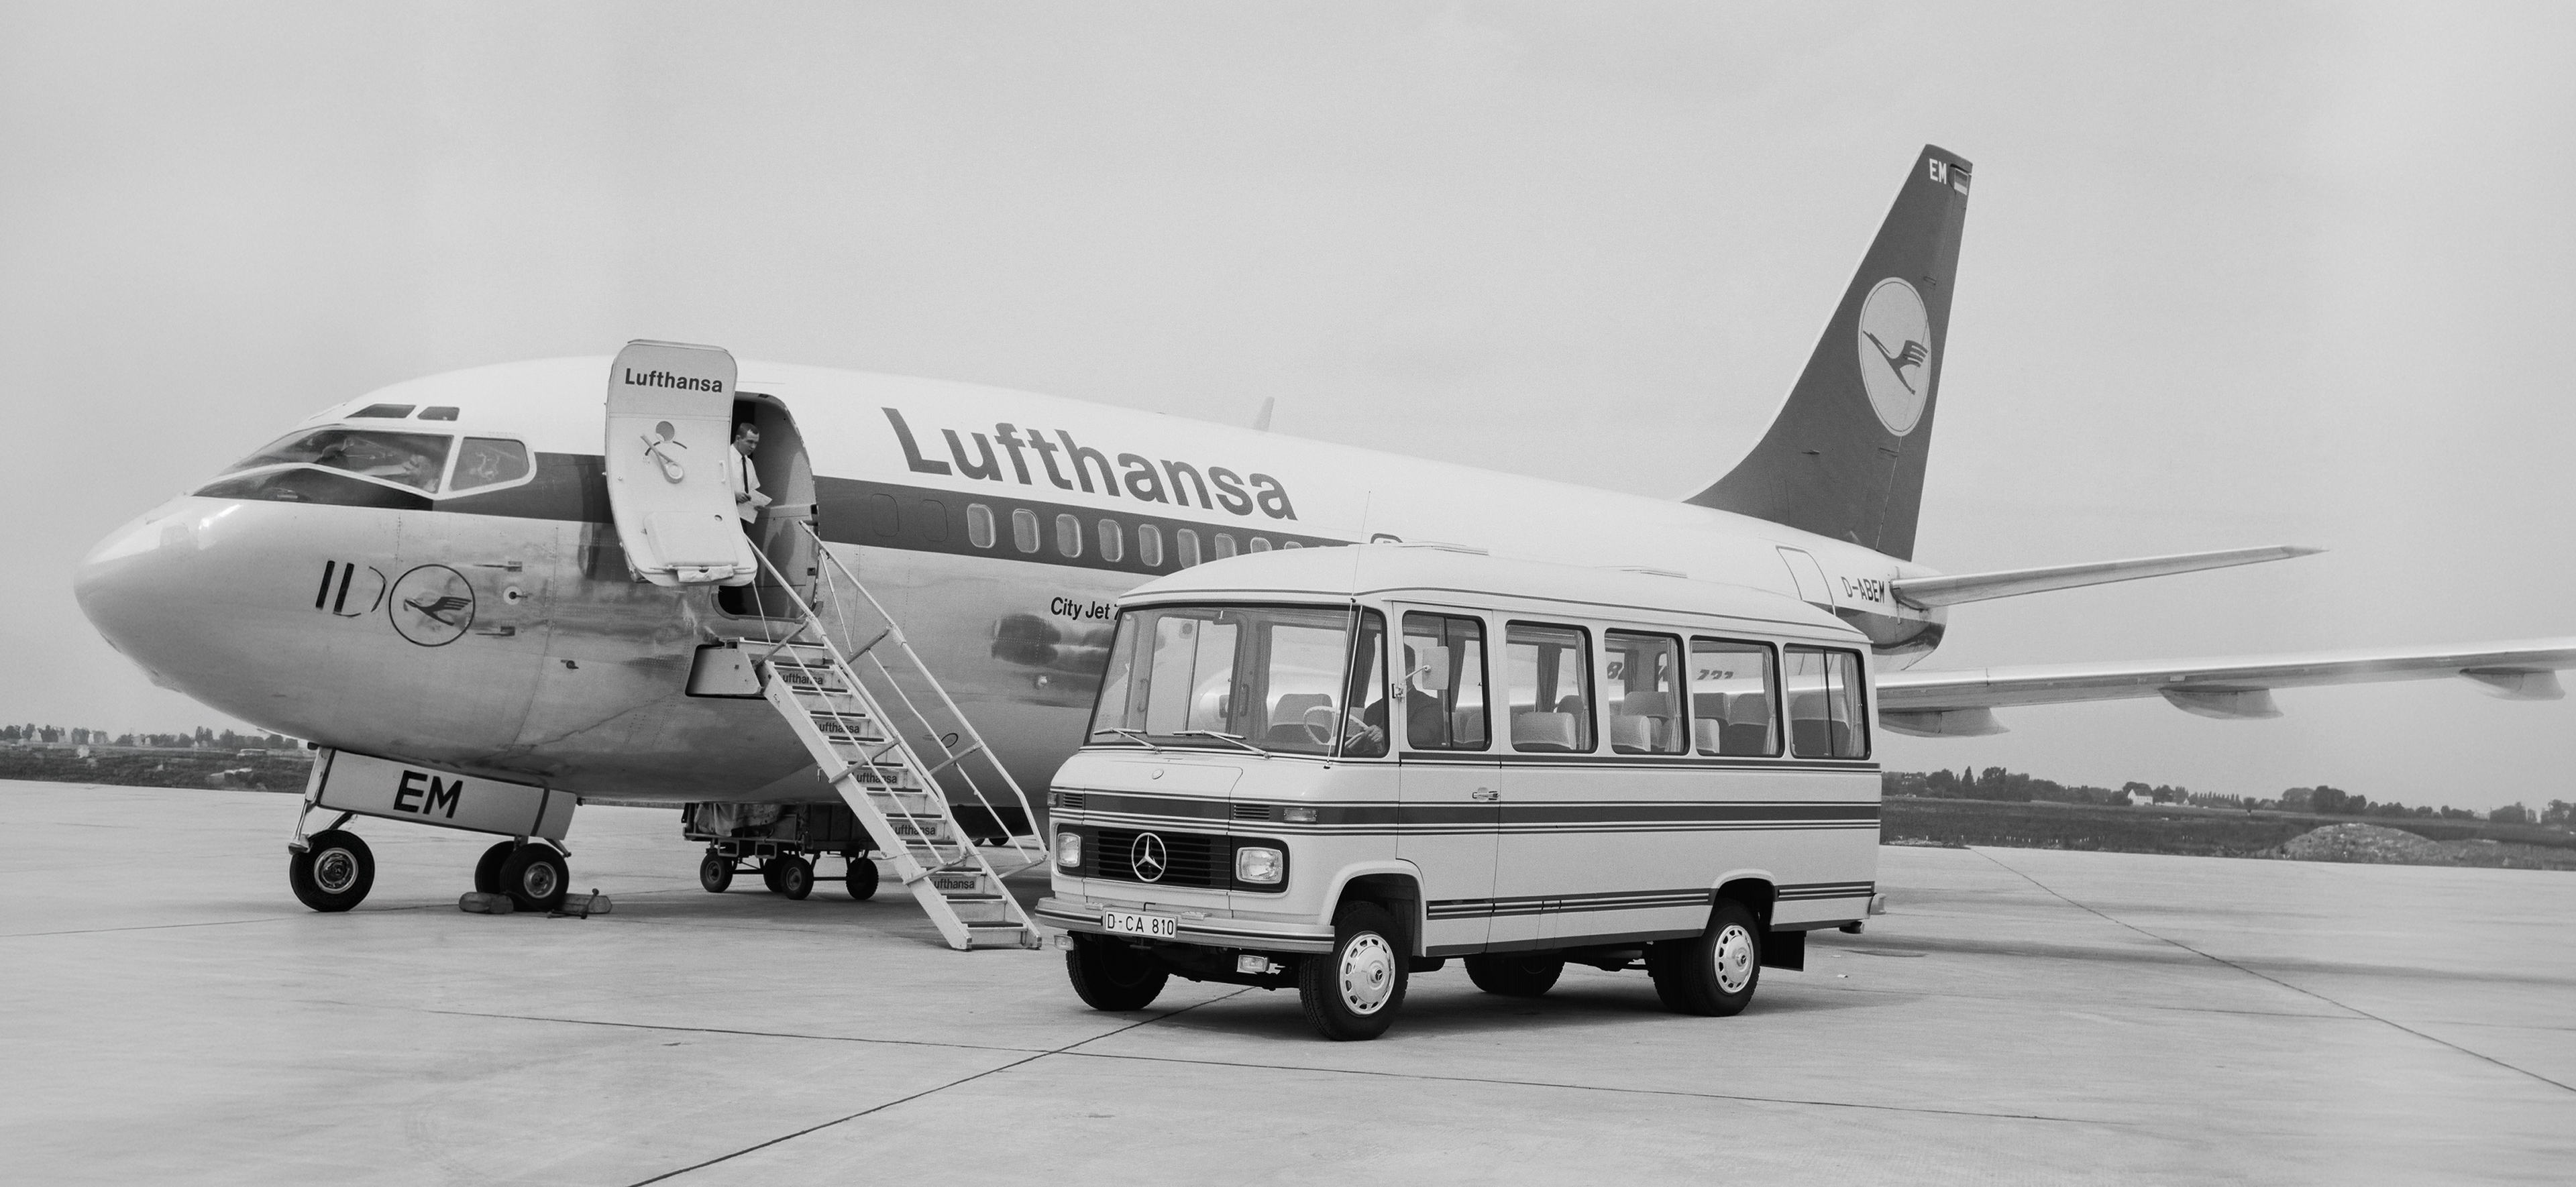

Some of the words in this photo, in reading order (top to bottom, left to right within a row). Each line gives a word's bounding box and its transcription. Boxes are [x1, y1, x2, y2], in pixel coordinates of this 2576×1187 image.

[1929, 158, 1947, 184] EM
[625, 368, 723, 393] Lufthansa
[881, 406, 1299, 521] Lufthansa
[1840, 576, 1884, 604] D-ABEM
[1051, 596, 1082, 620] City
[1085, 601, 1110, 620] Jet
[392, 770, 464, 819] EM
[930, 878, 975, 889] ufthansa
[1108, 913, 1144, 932] D-CA
[1152, 919, 1174, 935] 810
